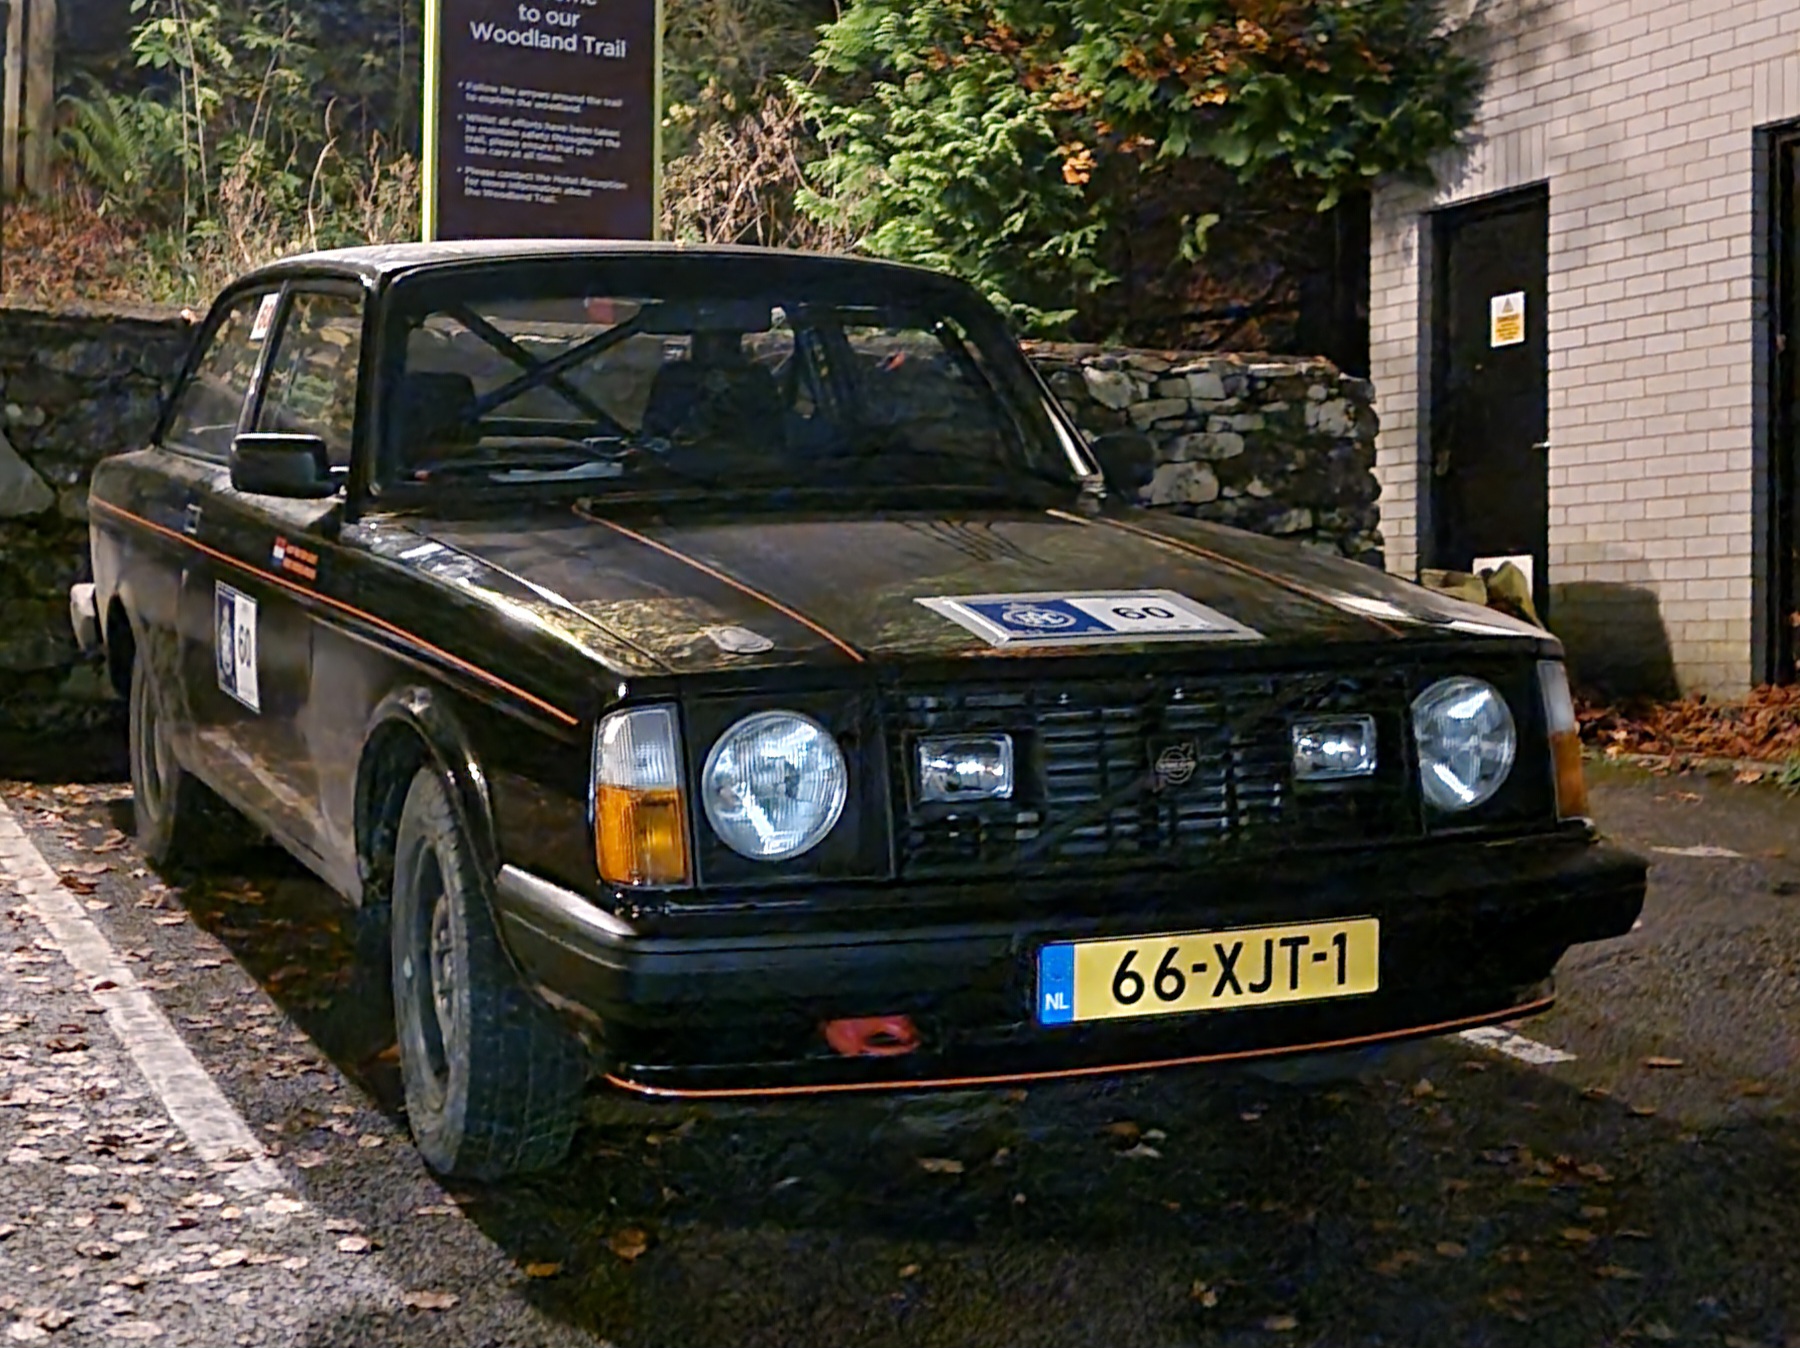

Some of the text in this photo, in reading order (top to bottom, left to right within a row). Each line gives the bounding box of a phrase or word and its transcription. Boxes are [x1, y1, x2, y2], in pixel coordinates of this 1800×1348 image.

[518, 3, 581, 28] to our
[470, 21, 627, 58] Woodland Trail
[465, 92, 478, 102] to
[478, 95, 514, 106] explore
[516, 98, 532, 108] the
[501, 85, 516, 96] the
[552, 91, 586, 104] around
[586, 95, 602, 106] the
[604, 97, 624, 108] trail
[465, 124, 621, 149] to maintain safety throughout the
[498, 116, 511, 126] all
[511, 118, 543, 130] efforts
[544, 121, 568, 133] have
[569, 124, 593, 135] been
[594, 127, 621, 138] taken
[464, 144, 487, 155] take
[488, 148, 510, 158] care
[511, 150, 522, 159] at
[523, 151, 535, 160] all
[488, 137, 520, 148] please
[521, 141, 554, 151] ensure
[555, 144, 574, 154] that
[575, 147, 594, 157] you
[464, 165, 628, 190] Please contact the Hotel Reception
[464, 176, 593, 197] for more information about
[464, 187, 482, 197] the
[482, 189, 532, 202] Woodland
[1112, 606, 1175, 620] 60
[1112, 932, 1348, 1006] 66-XJT-1
[1045, 993, 1069, 1012] NL
